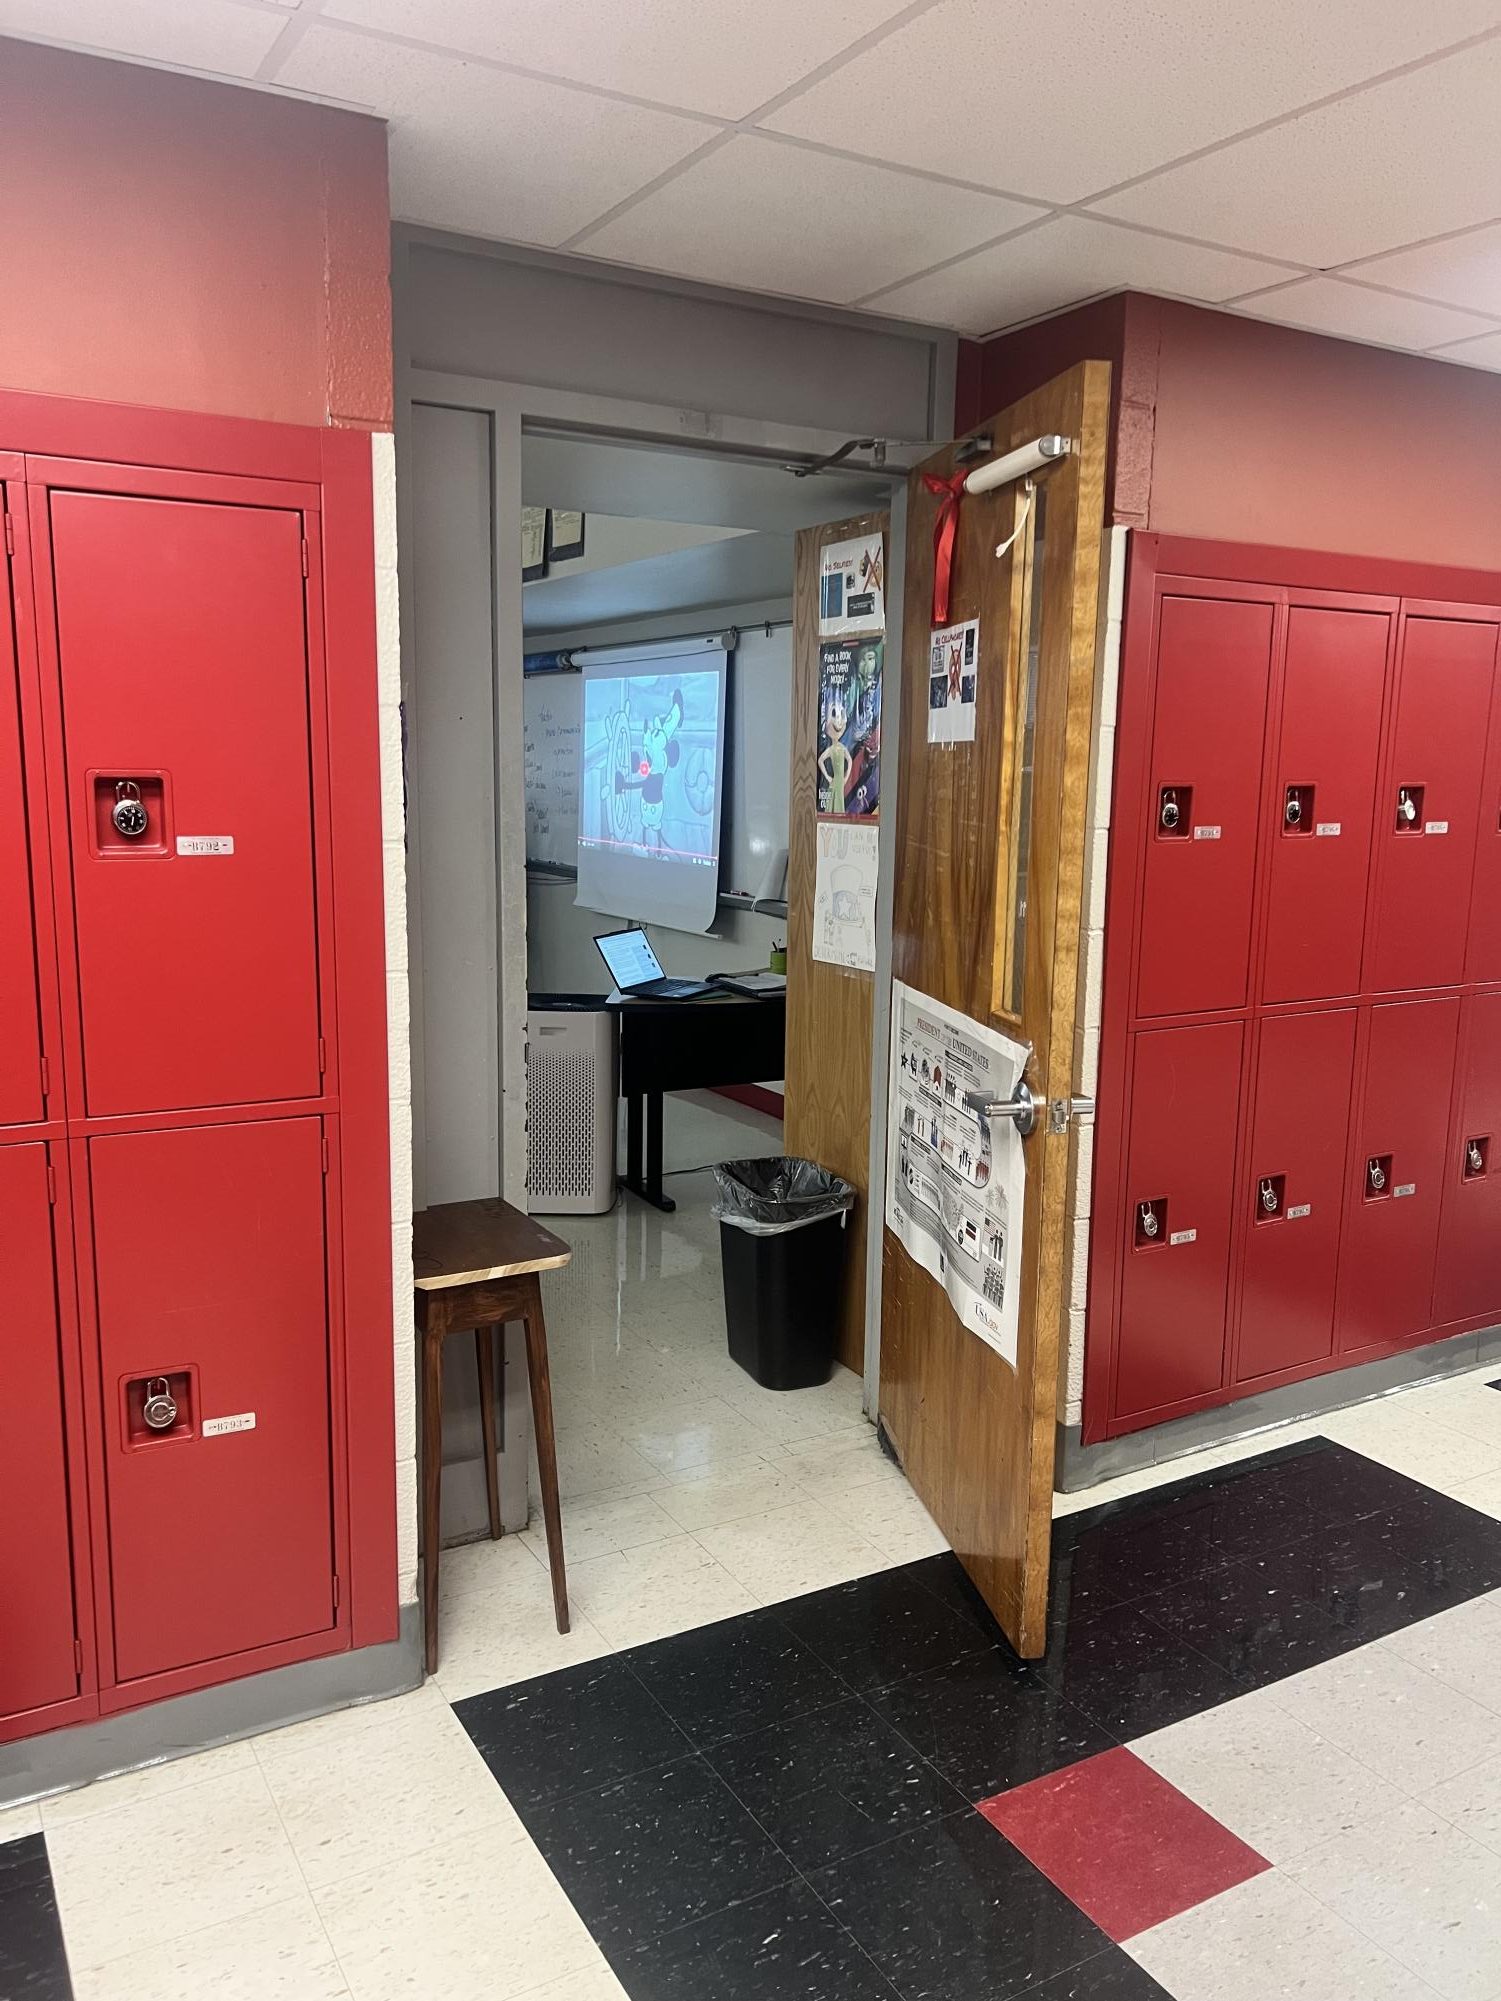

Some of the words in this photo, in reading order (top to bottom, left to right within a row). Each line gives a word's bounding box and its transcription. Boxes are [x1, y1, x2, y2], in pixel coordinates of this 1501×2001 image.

[824, 653, 834, 663] FIND
[835, 653, 839, 663] A
[839, 650, 852, 662] BOOK
[826, 664, 835, 674] FOR
[917, 1017, 941, 1039] PRESIDENT
[952, 1038, 973, 1057] UNITED
[972, 1049, 989, 1069] STATES
